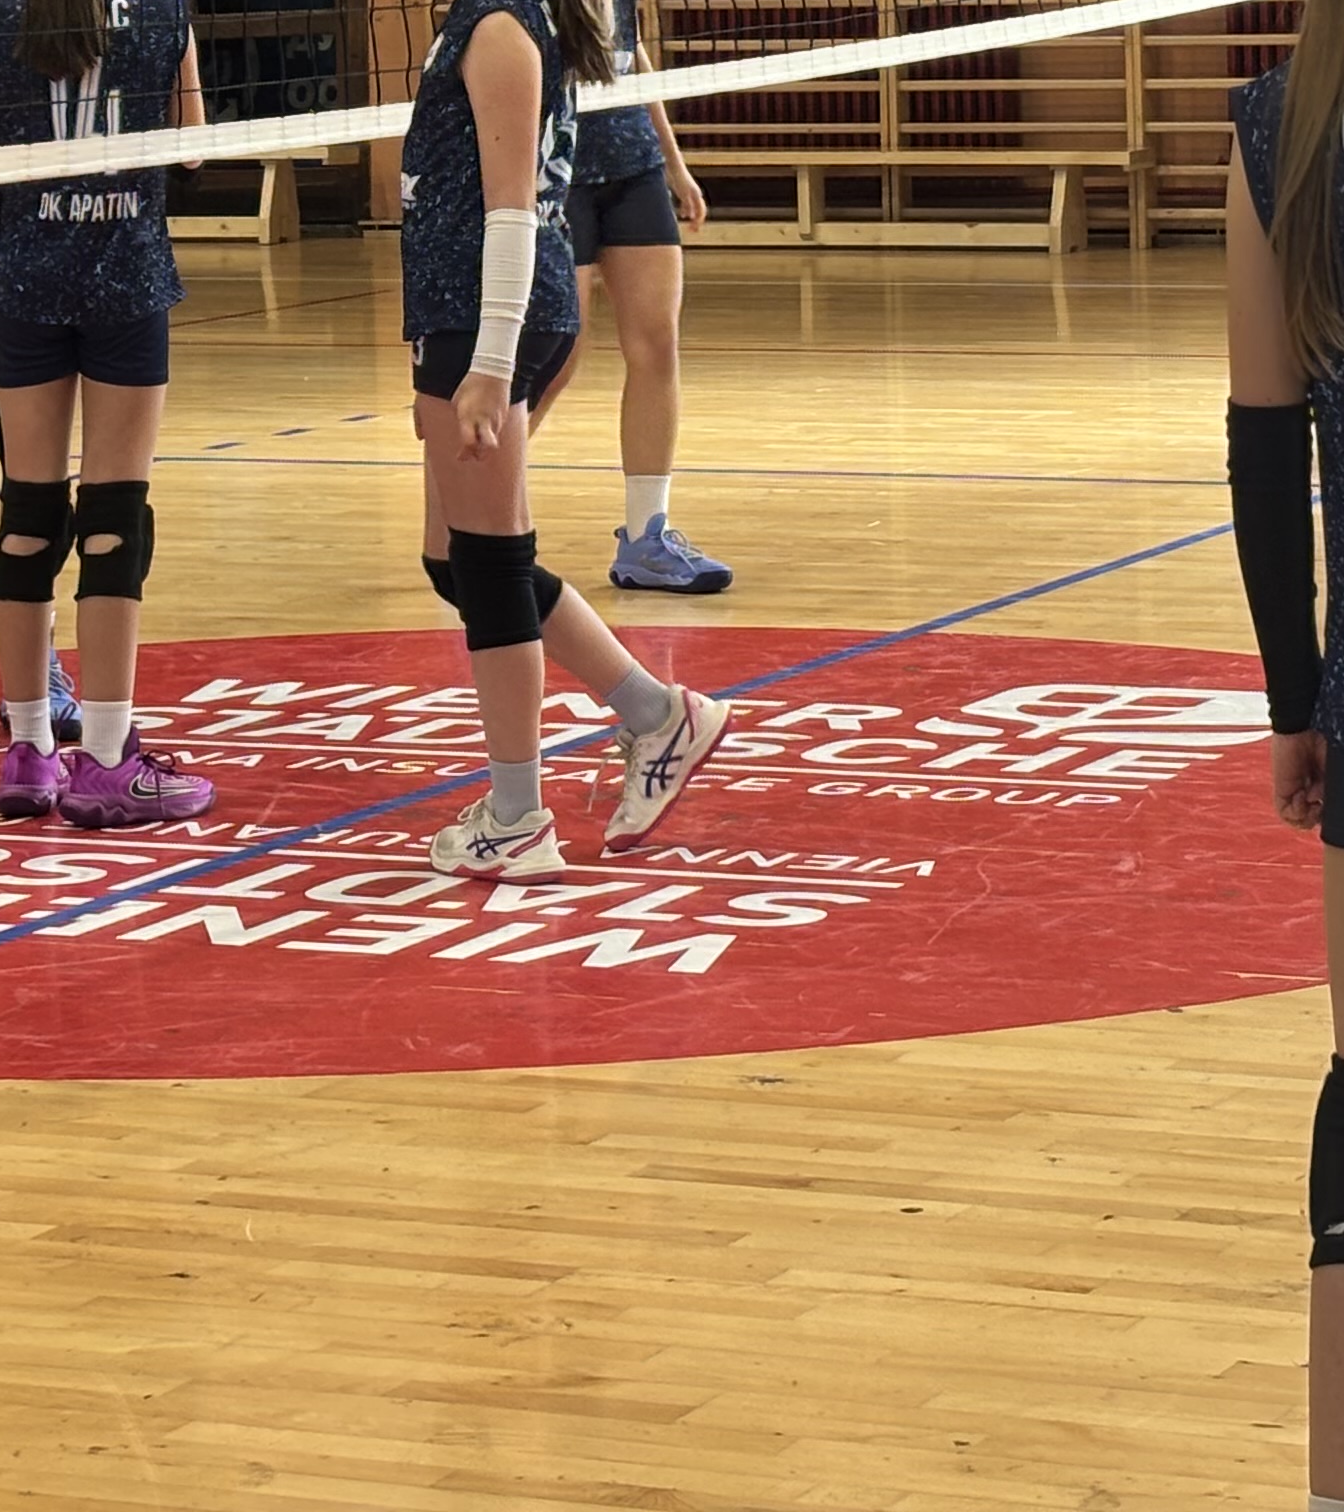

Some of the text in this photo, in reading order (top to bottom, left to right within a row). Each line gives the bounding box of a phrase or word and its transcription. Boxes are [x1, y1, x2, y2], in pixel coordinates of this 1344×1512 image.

[38, 191, 139, 223] OK APATIN
[806, 781, 1123, 808] GROUP
